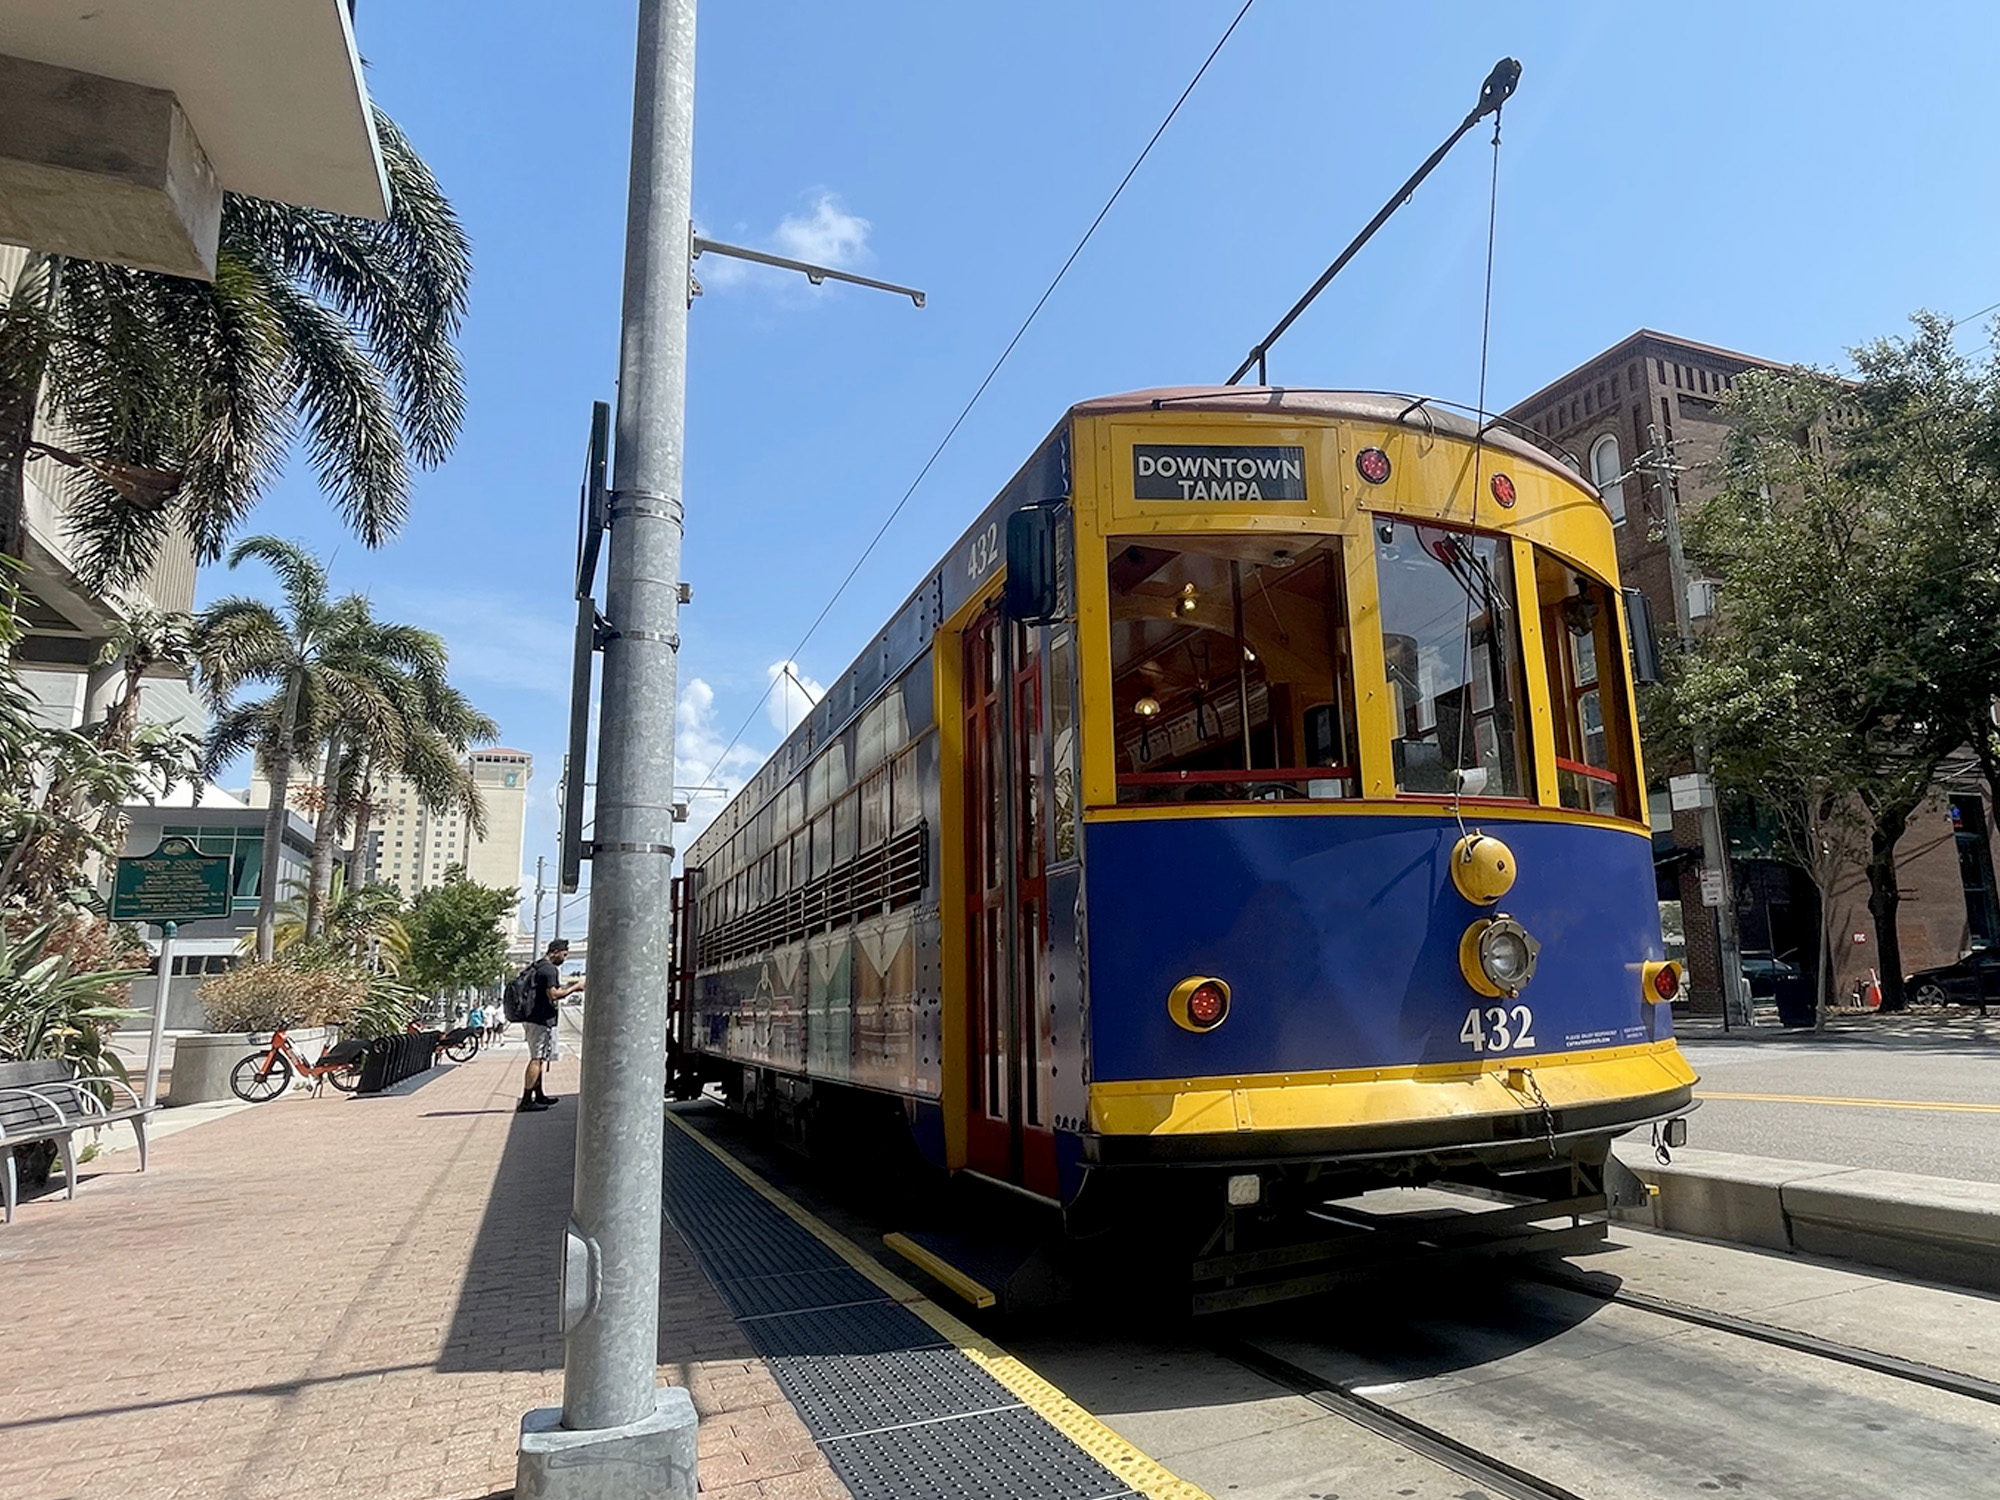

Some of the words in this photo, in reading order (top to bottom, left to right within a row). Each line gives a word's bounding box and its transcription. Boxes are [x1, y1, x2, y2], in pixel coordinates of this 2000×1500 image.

[1138, 455, 1300, 480] DOWNTOWN
[1177, 480, 1265, 501] TAMPA
[967, 521, 999, 581] 432
[1459, 1004, 1536, 1052] 432
